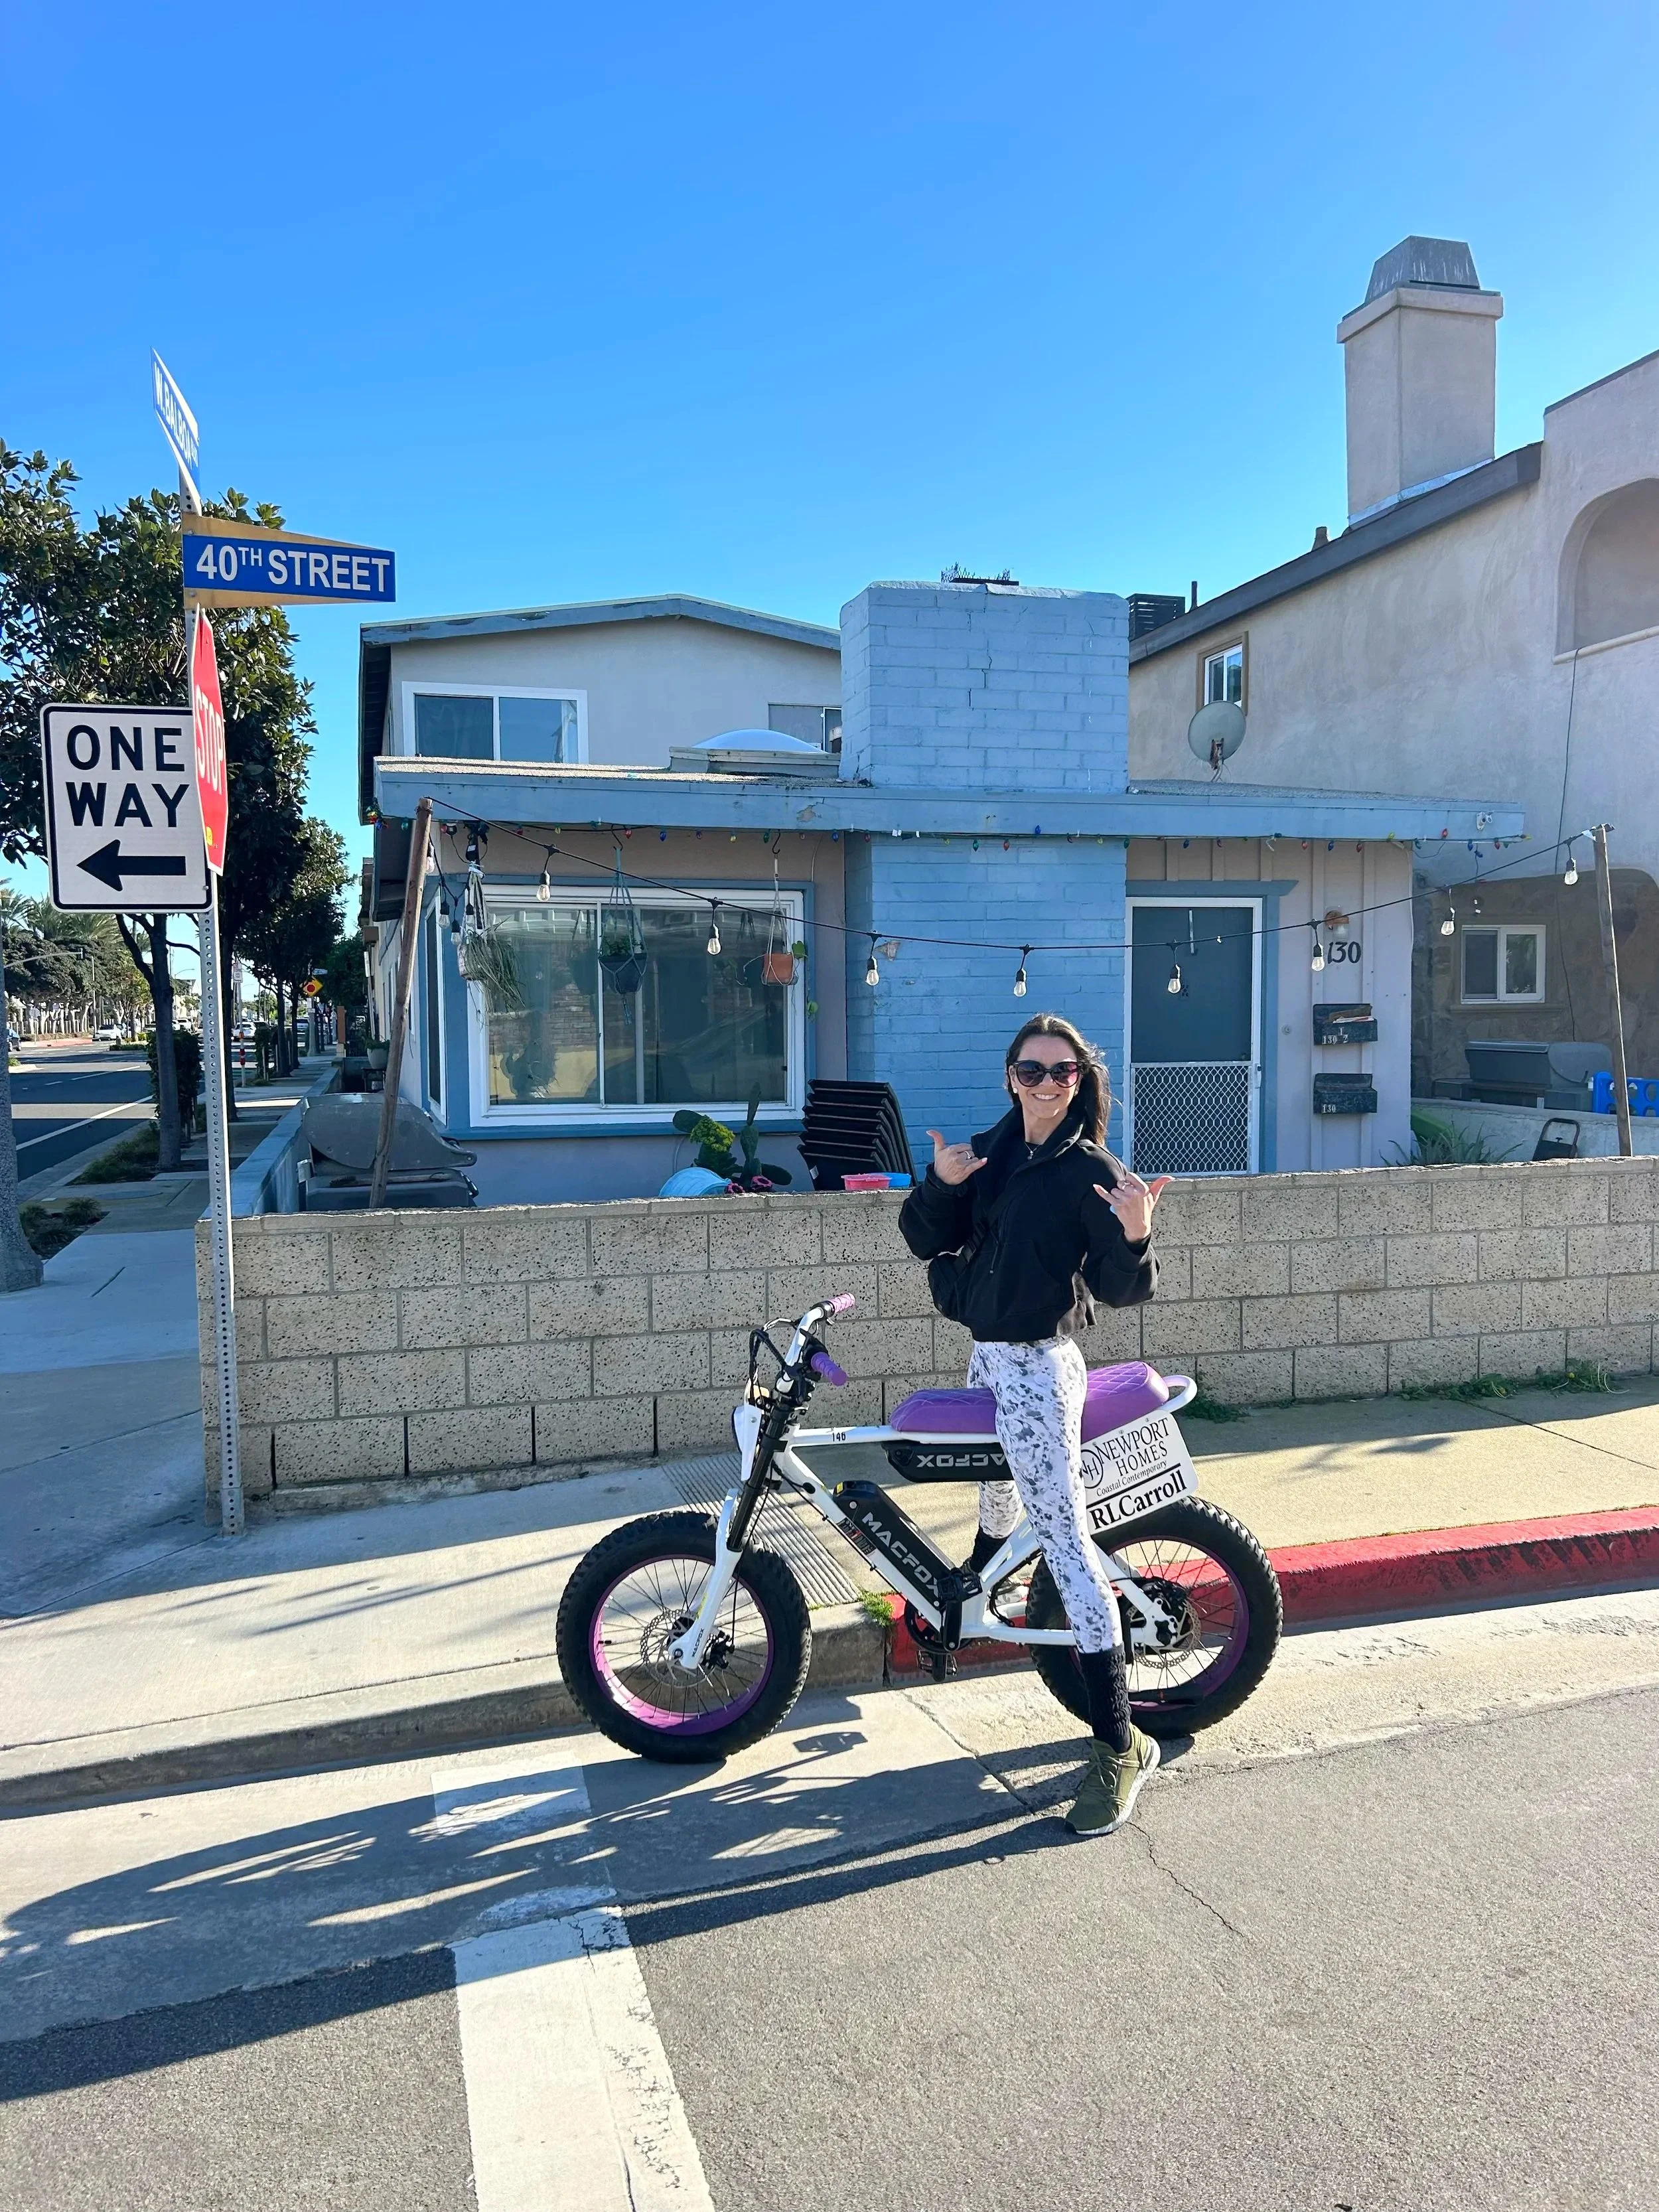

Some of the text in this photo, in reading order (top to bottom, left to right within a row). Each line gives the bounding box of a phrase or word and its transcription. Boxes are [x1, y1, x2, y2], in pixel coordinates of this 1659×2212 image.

[268, 549, 390, 592] STREET
[66, 725, 185, 772] ONE
[196, 685, 225, 796] STOP
[65, 782, 190, 828] WAY
[1327, 941, 1362, 964] 130
[1321, 1035, 1337, 1045] 130
[1321, 1104, 1336, 1114] 130
[916, 1453, 1007, 1467] ACFOX
[1095, 1418, 1170, 1464] NEWPORT
[1116, 1441, 1168, 1476] HOMES
[1096, 1460, 1167, 1497] Coastal Contemporary
[862, 1512, 939, 1597] MACFOX
